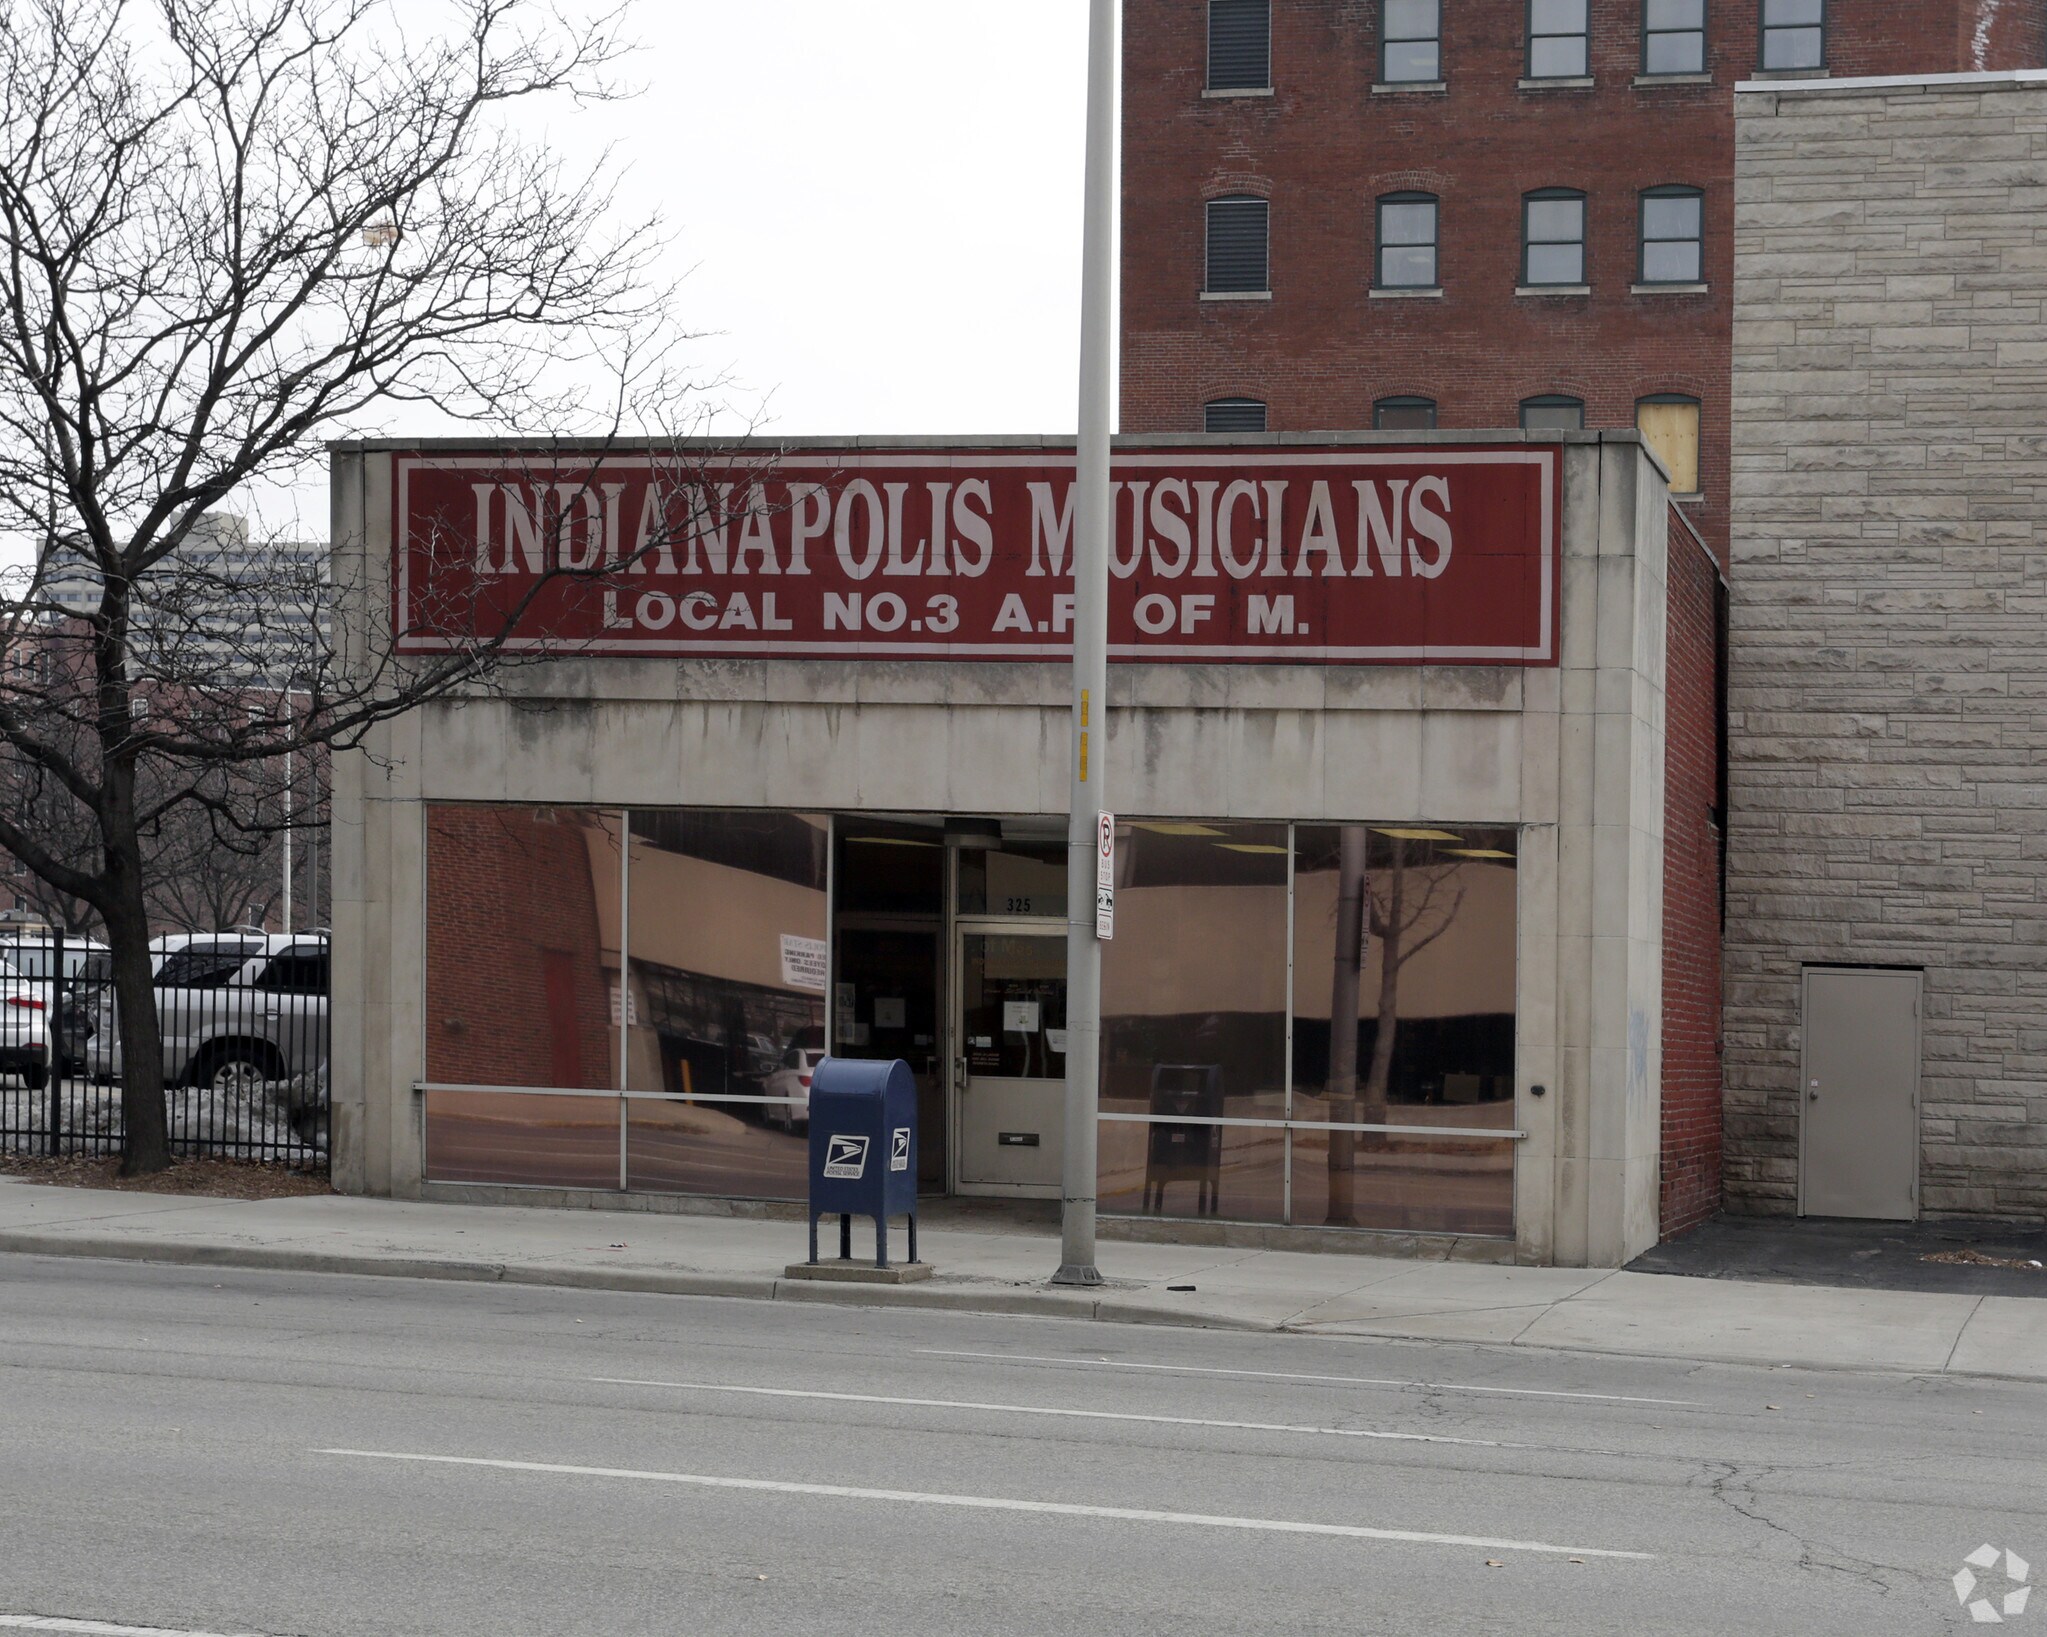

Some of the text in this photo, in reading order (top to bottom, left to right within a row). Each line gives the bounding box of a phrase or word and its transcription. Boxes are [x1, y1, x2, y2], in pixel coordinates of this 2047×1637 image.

[471, 475, 1453, 580] INDIANAPOLIS MUSICIANS
[603, 591, 793, 631] LOCAL
[823, 592, 960, 632] NO.3
[1133, 593, 1215, 634] OF
[1247, 594, 1309, 634] M.
[1007, 897, 1031, 912] 325
